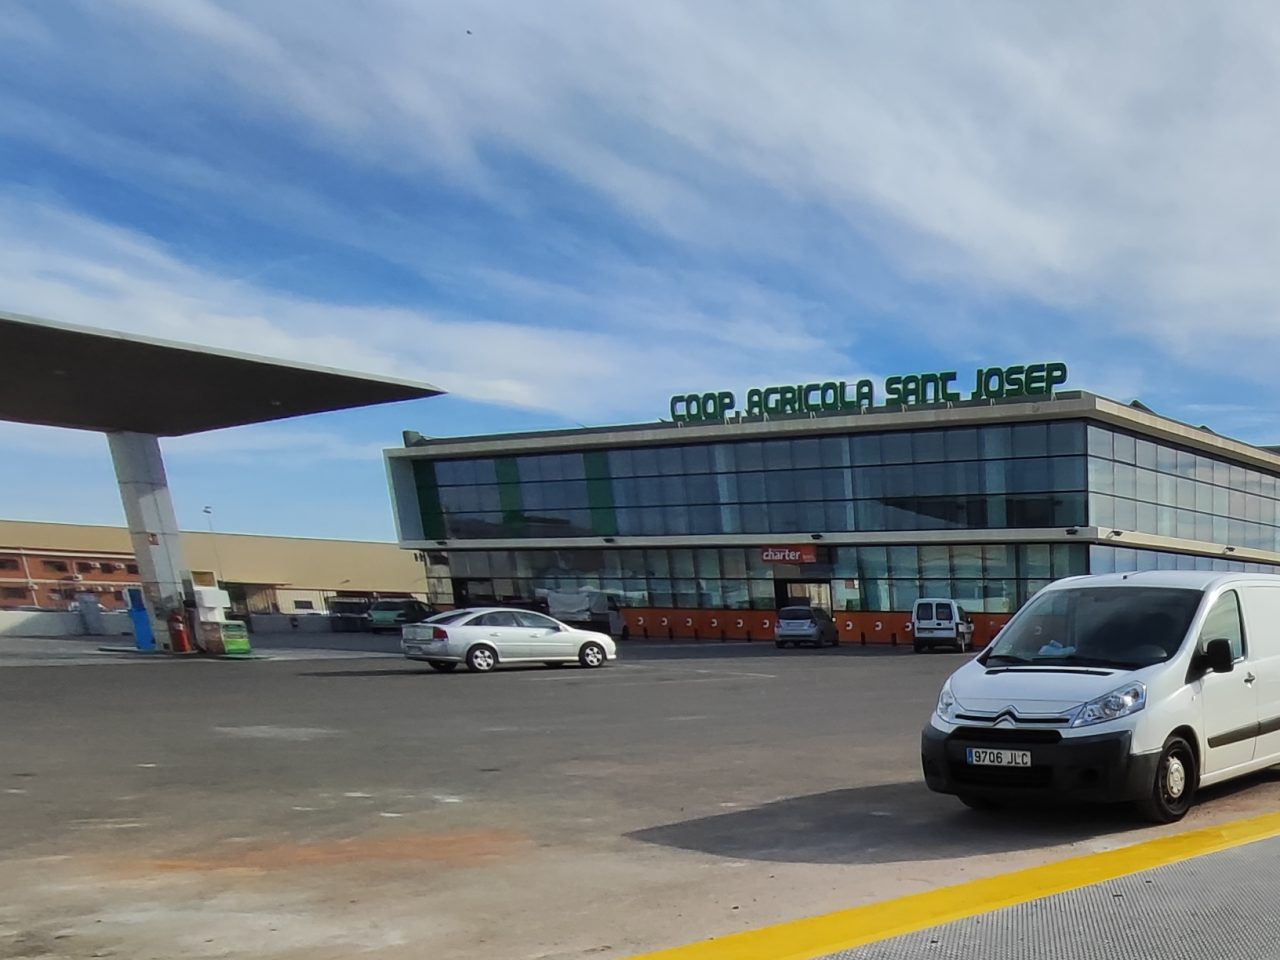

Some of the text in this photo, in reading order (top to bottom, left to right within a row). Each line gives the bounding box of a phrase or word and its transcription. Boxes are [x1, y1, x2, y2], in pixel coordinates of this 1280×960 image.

[747, 379, 873, 417] AGRICOLA
[885, 371, 961, 406] SANT
[971, 362, 1068, 400] JOSEP
[763, 548, 800, 560] charter
[974, 750, 1029, 765] 9706 JLC
